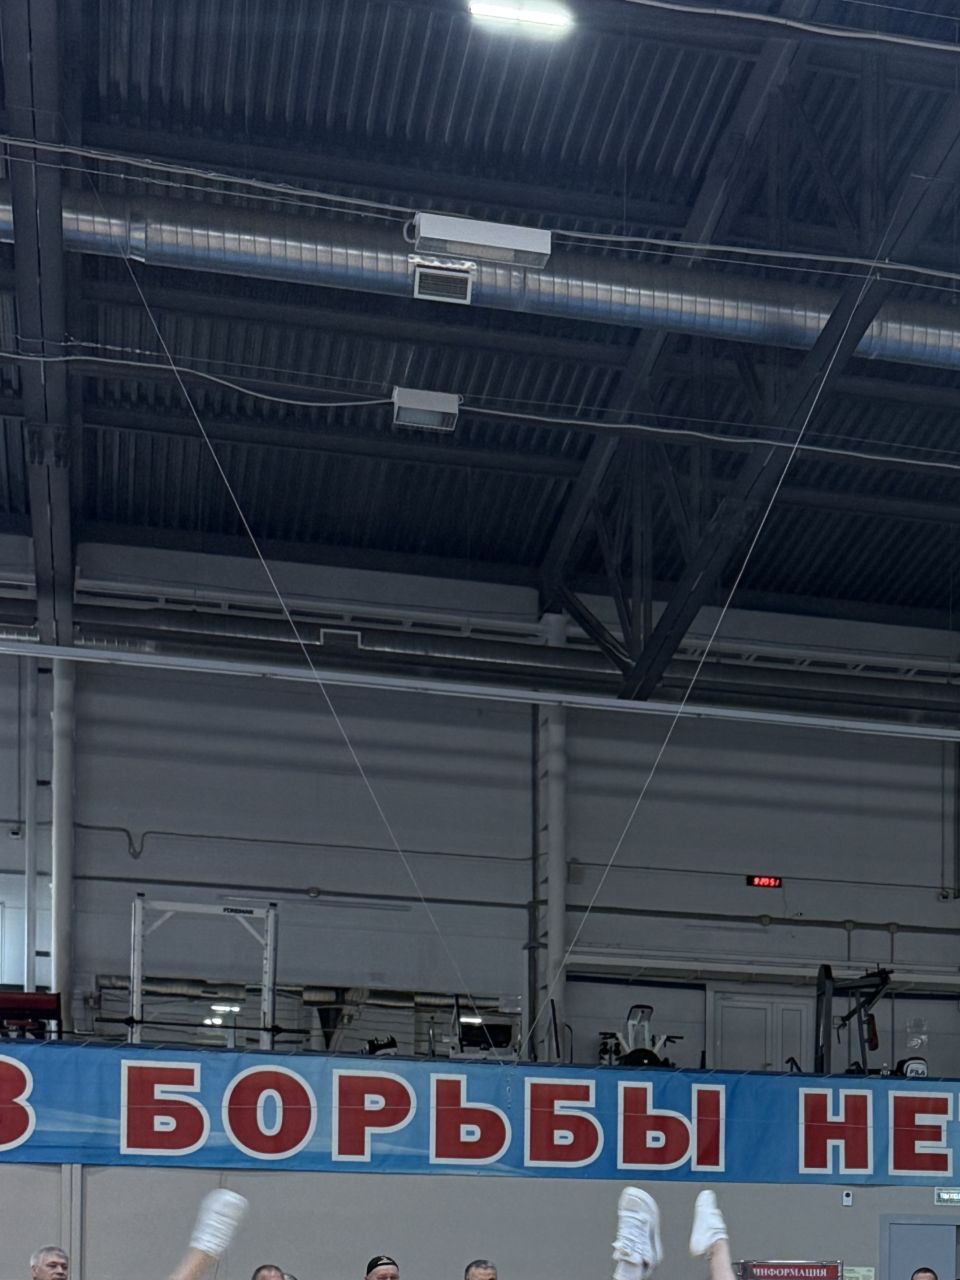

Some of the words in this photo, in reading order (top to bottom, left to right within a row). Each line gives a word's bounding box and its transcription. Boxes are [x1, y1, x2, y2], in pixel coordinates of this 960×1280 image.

[909, 1069, 926, 1077] FILA
[119, 1059, 726, 1173] БОРЬБЫ
[752, 1267, 828, 1278] ИНФОРМАЦИЯ
